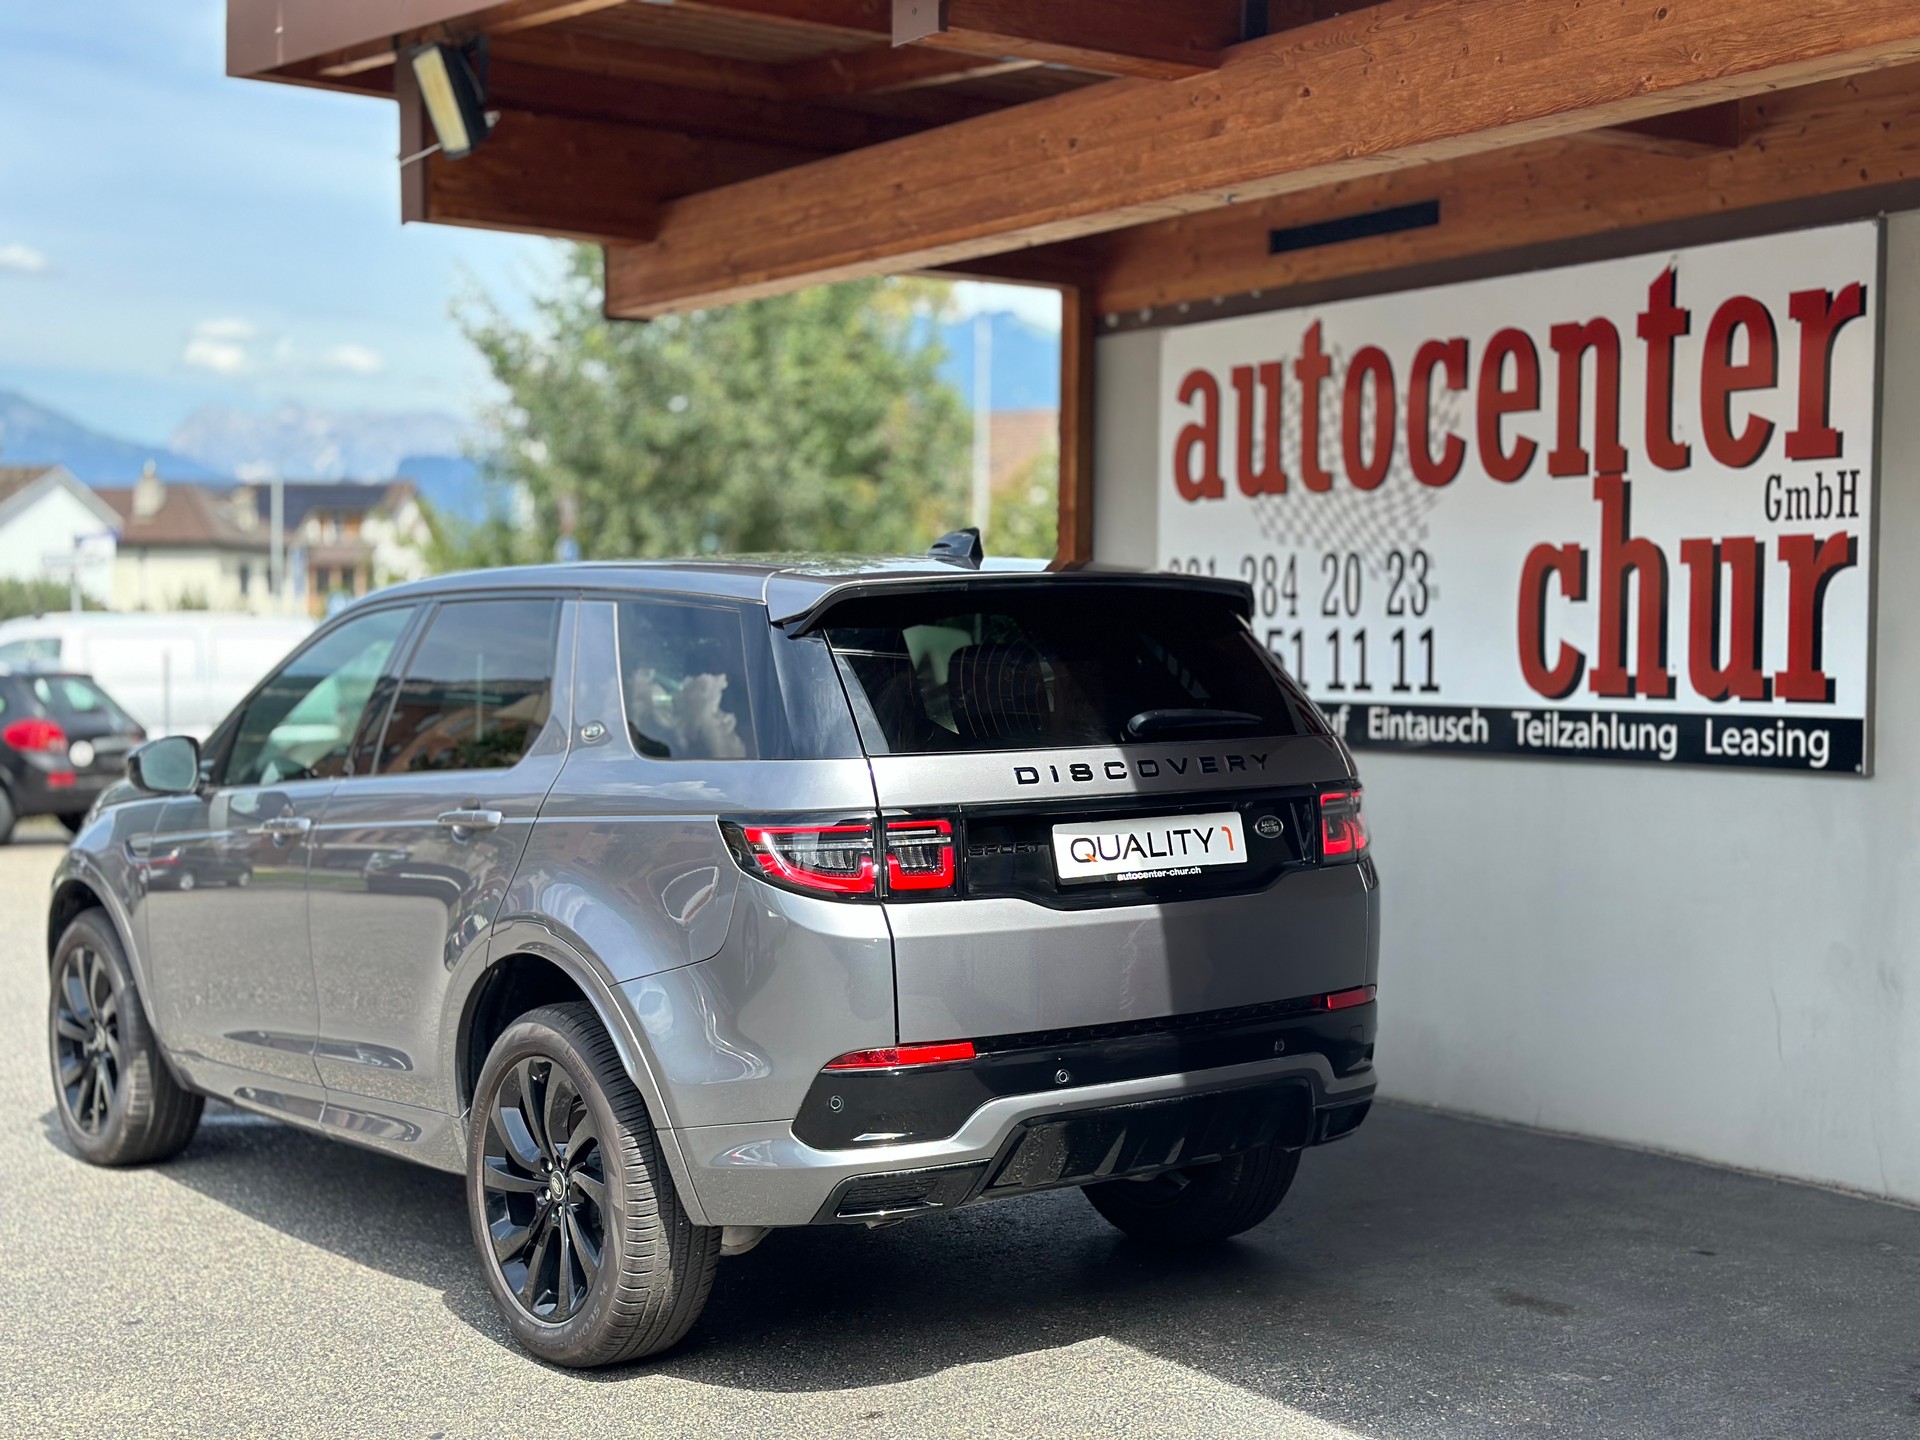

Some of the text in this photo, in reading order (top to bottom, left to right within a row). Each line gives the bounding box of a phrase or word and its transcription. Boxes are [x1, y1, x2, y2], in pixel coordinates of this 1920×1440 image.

[1173, 260, 1867, 502] autocenter
[1764, 468, 1861, 522] GmbH
[1321, 552, 1361, 618] 20
[1386, 549, 1430, 618] 23
[1517, 472, 1857, 704] chur
[1326, 627, 1373, 693] 11
[1391, 626, 1441, 694] 11
[1367, 706, 1489, 745] Eintausch
[1511, 711, 1679, 761] Teilzahlung
[1704, 718, 1831, 769] Leasing
[1013, 753, 1269, 785] DISCOVERY
[967, 841, 1042, 857] SPORT
[1070, 827, 1215, 863] QUALITY
[1117, 866, 1202, 882] autocenter-chur.ch
